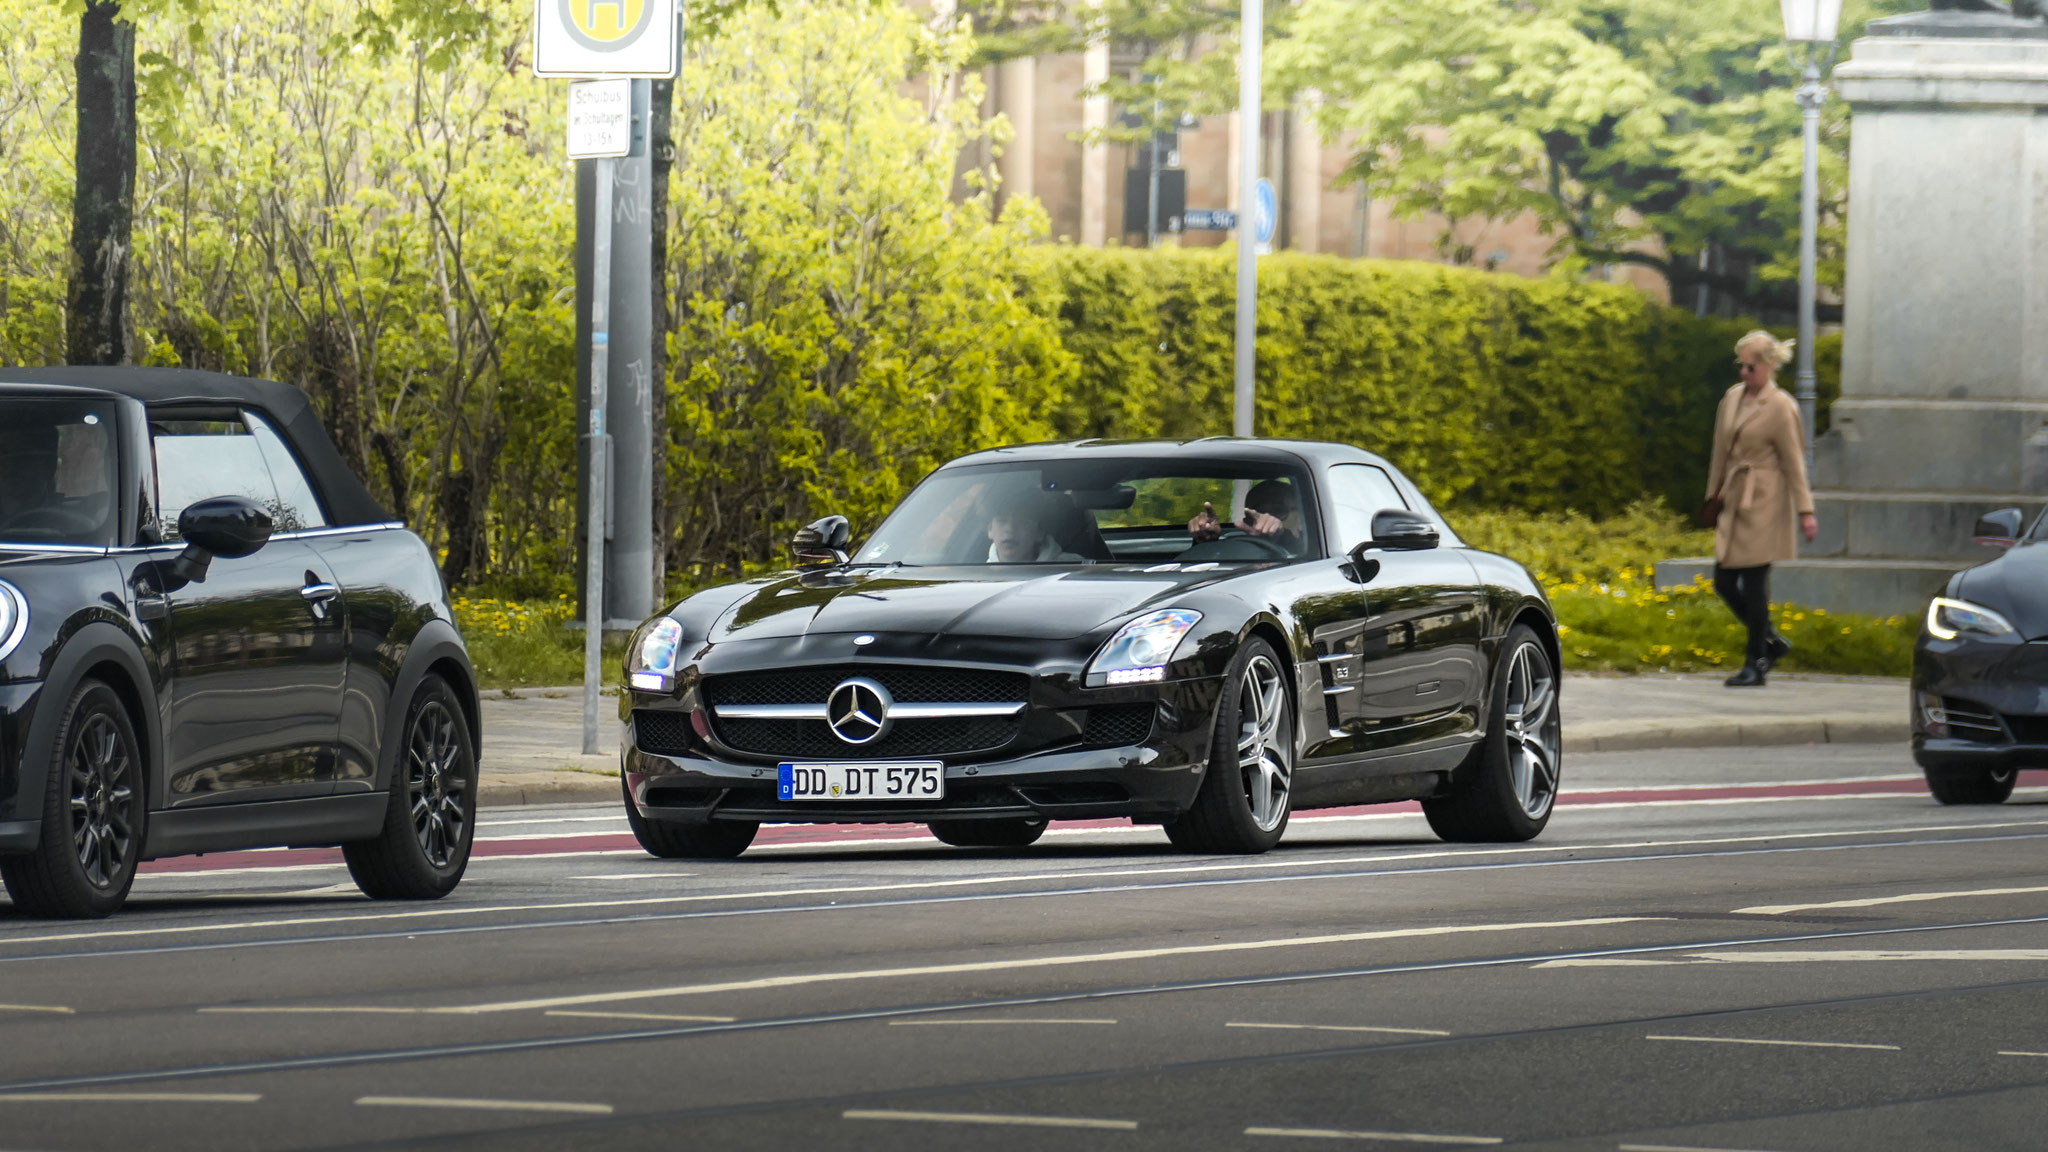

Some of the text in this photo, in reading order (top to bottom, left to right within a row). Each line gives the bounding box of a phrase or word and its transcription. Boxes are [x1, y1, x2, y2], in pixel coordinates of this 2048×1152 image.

[576, 89, 621, 104] Schulbus
[794, 767, 938, 796] DD DT 575
[782, 785, 789, 794] D
